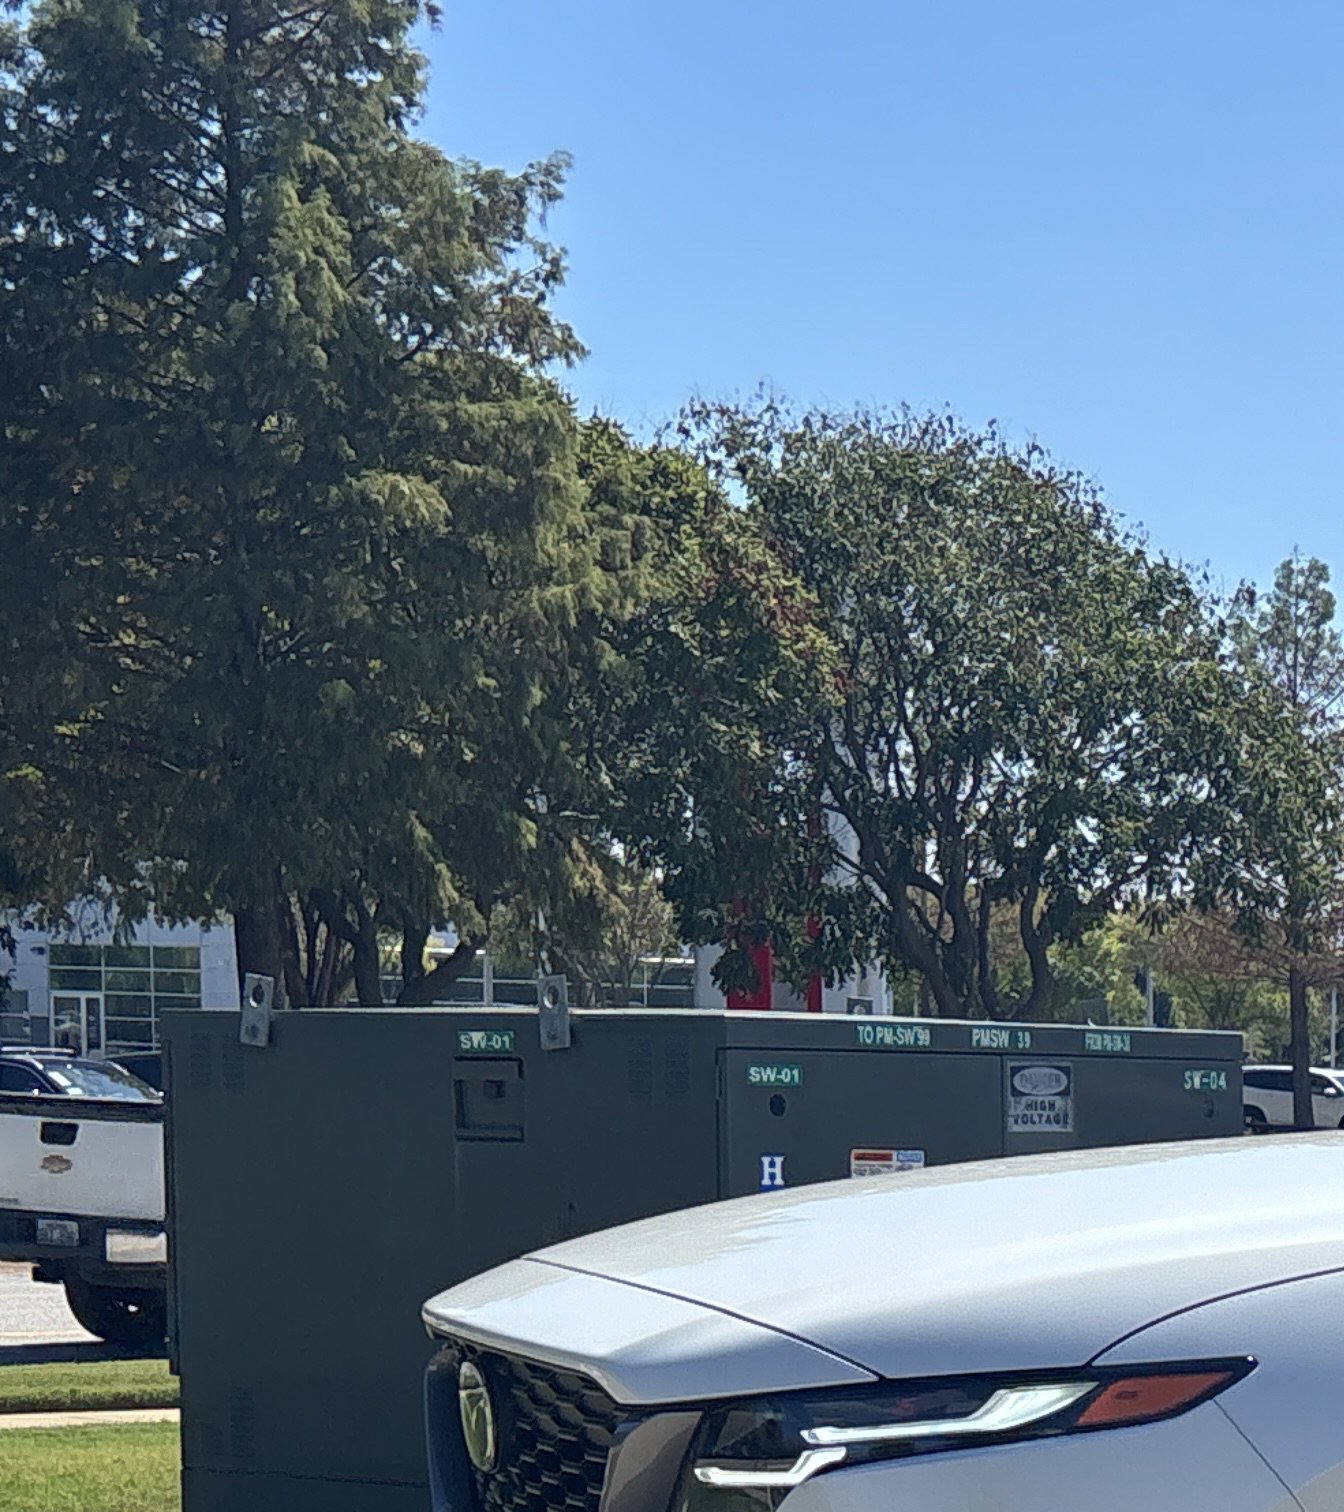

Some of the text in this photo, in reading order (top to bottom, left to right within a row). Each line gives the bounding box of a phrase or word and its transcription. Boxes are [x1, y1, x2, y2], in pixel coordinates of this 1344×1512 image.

[459, 1033, 510, 1049] SW-01
[857, 1025, 874, 1044] TO
[749, 1066, 800, 1083] SW-01
[1184, 1070, 1227, 1090] SW-04
[1024, 1099, 1056, 1112] HIGH
[760, 1156, 785, 1186] H
